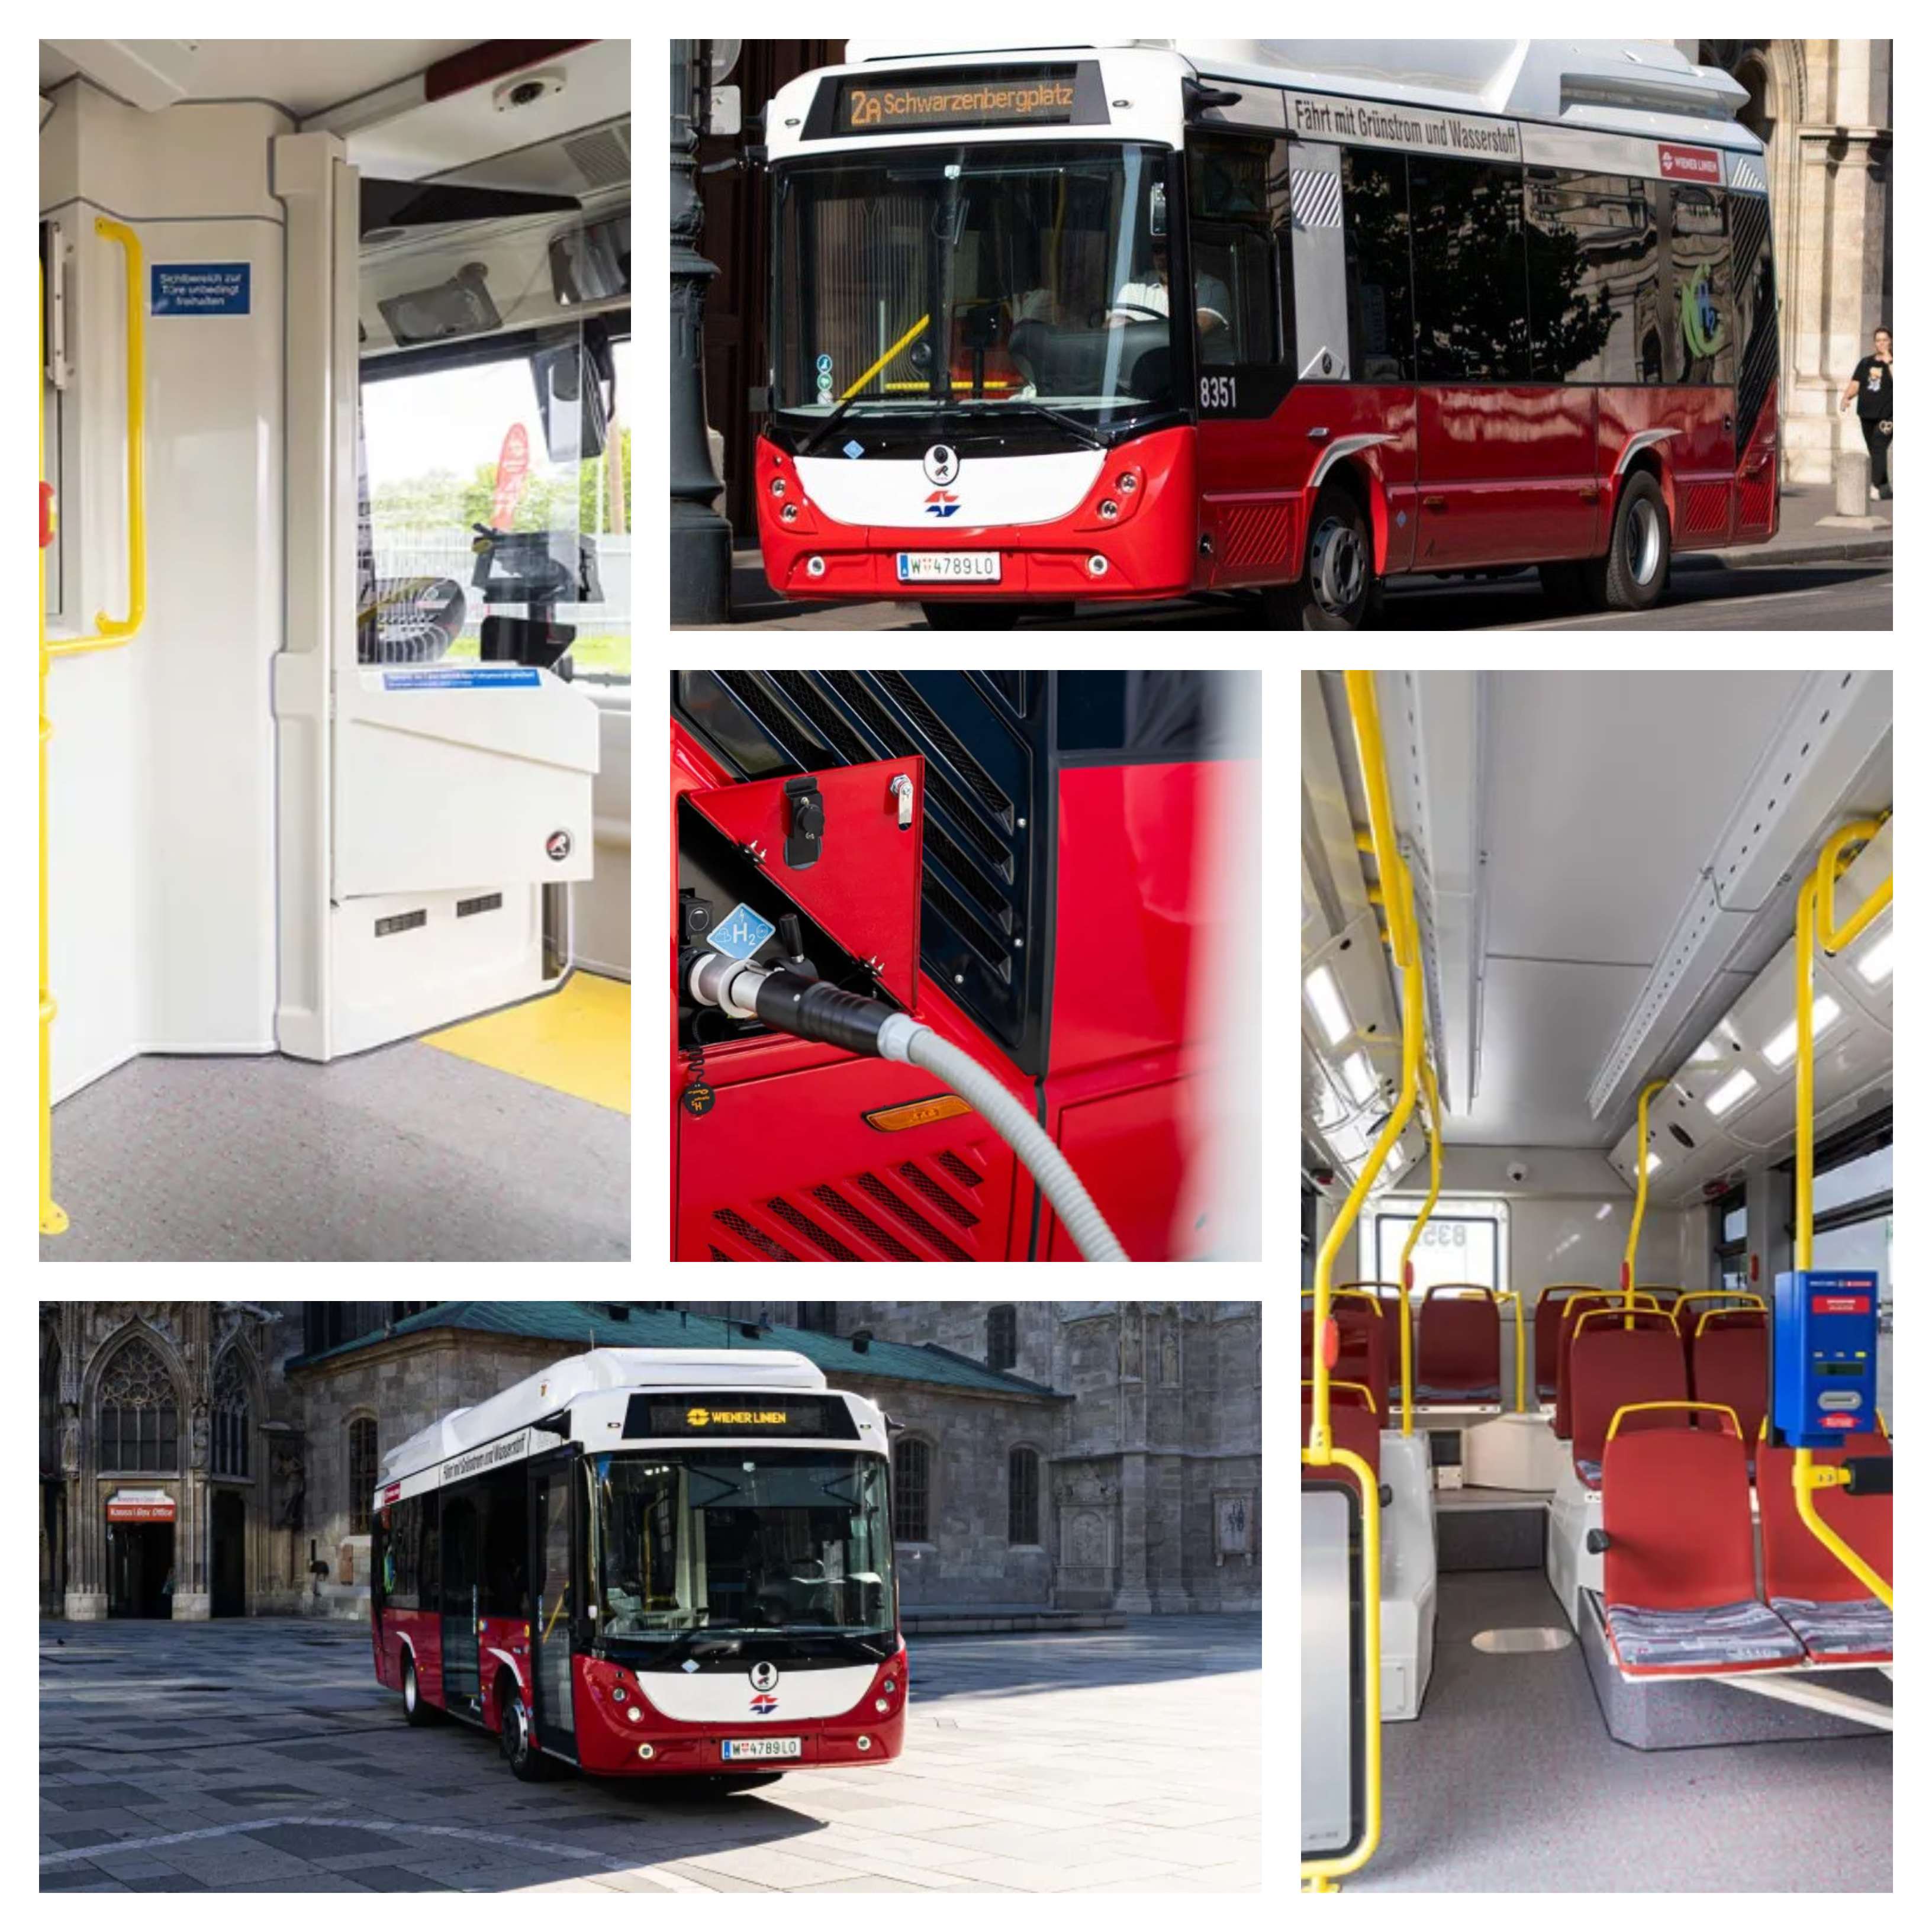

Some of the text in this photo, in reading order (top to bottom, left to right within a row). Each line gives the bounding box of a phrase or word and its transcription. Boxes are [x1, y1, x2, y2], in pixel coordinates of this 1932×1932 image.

[851, 83, 1074, 126] 2A Schwarzenbergplatz
[1295, 99, 1518, 154] Fährt mit Grünstrom und Wasserstoff
[1200, 376, 1236, 408] 8351
[711, 1411, 787, 1424] WIENER LINIEN
